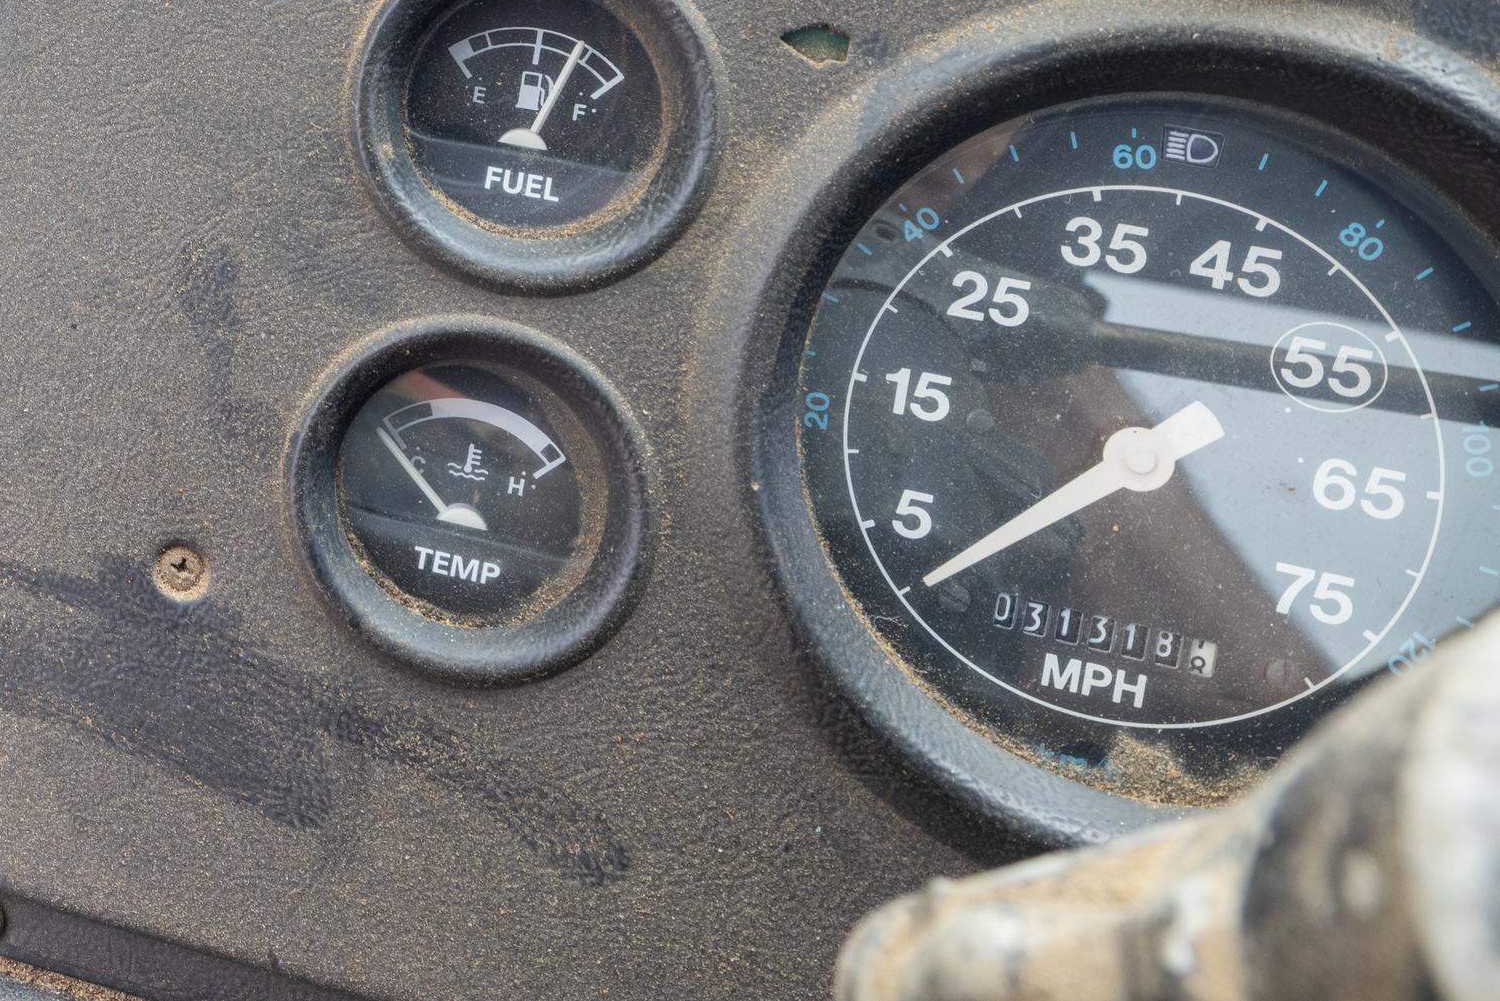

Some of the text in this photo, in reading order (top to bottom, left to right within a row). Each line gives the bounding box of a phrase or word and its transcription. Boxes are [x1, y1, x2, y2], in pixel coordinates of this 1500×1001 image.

[472, 86, 487, 104] E
[572, 103, 587, 121] F
[1112, 144, 1156, 169] 60
[484, 166, 559, 203] FUEL
[903, 207, 940, 243] 40
[1061, 216, 1149, 274] 35
[1339, 222, 1384, 261] 80
[1189, 240, 1283, 297] 45
[946, 270, 1032, 327] 25
[1280, 336, 1373, 397] 55
[804, 391, 830, 430] 20
[885, 367, 953, 422] 15
[1462, 421, 1494, 477] 100
[507, 476, 526, 497] H
[1313, 458, 1407, 520] 65
[892, 489, 934, 540] 5
[415, 545, 501, 585] TEMP
[1275, 561, 1355, 625] 75
[1041, 653, 1147, 709] MPH
